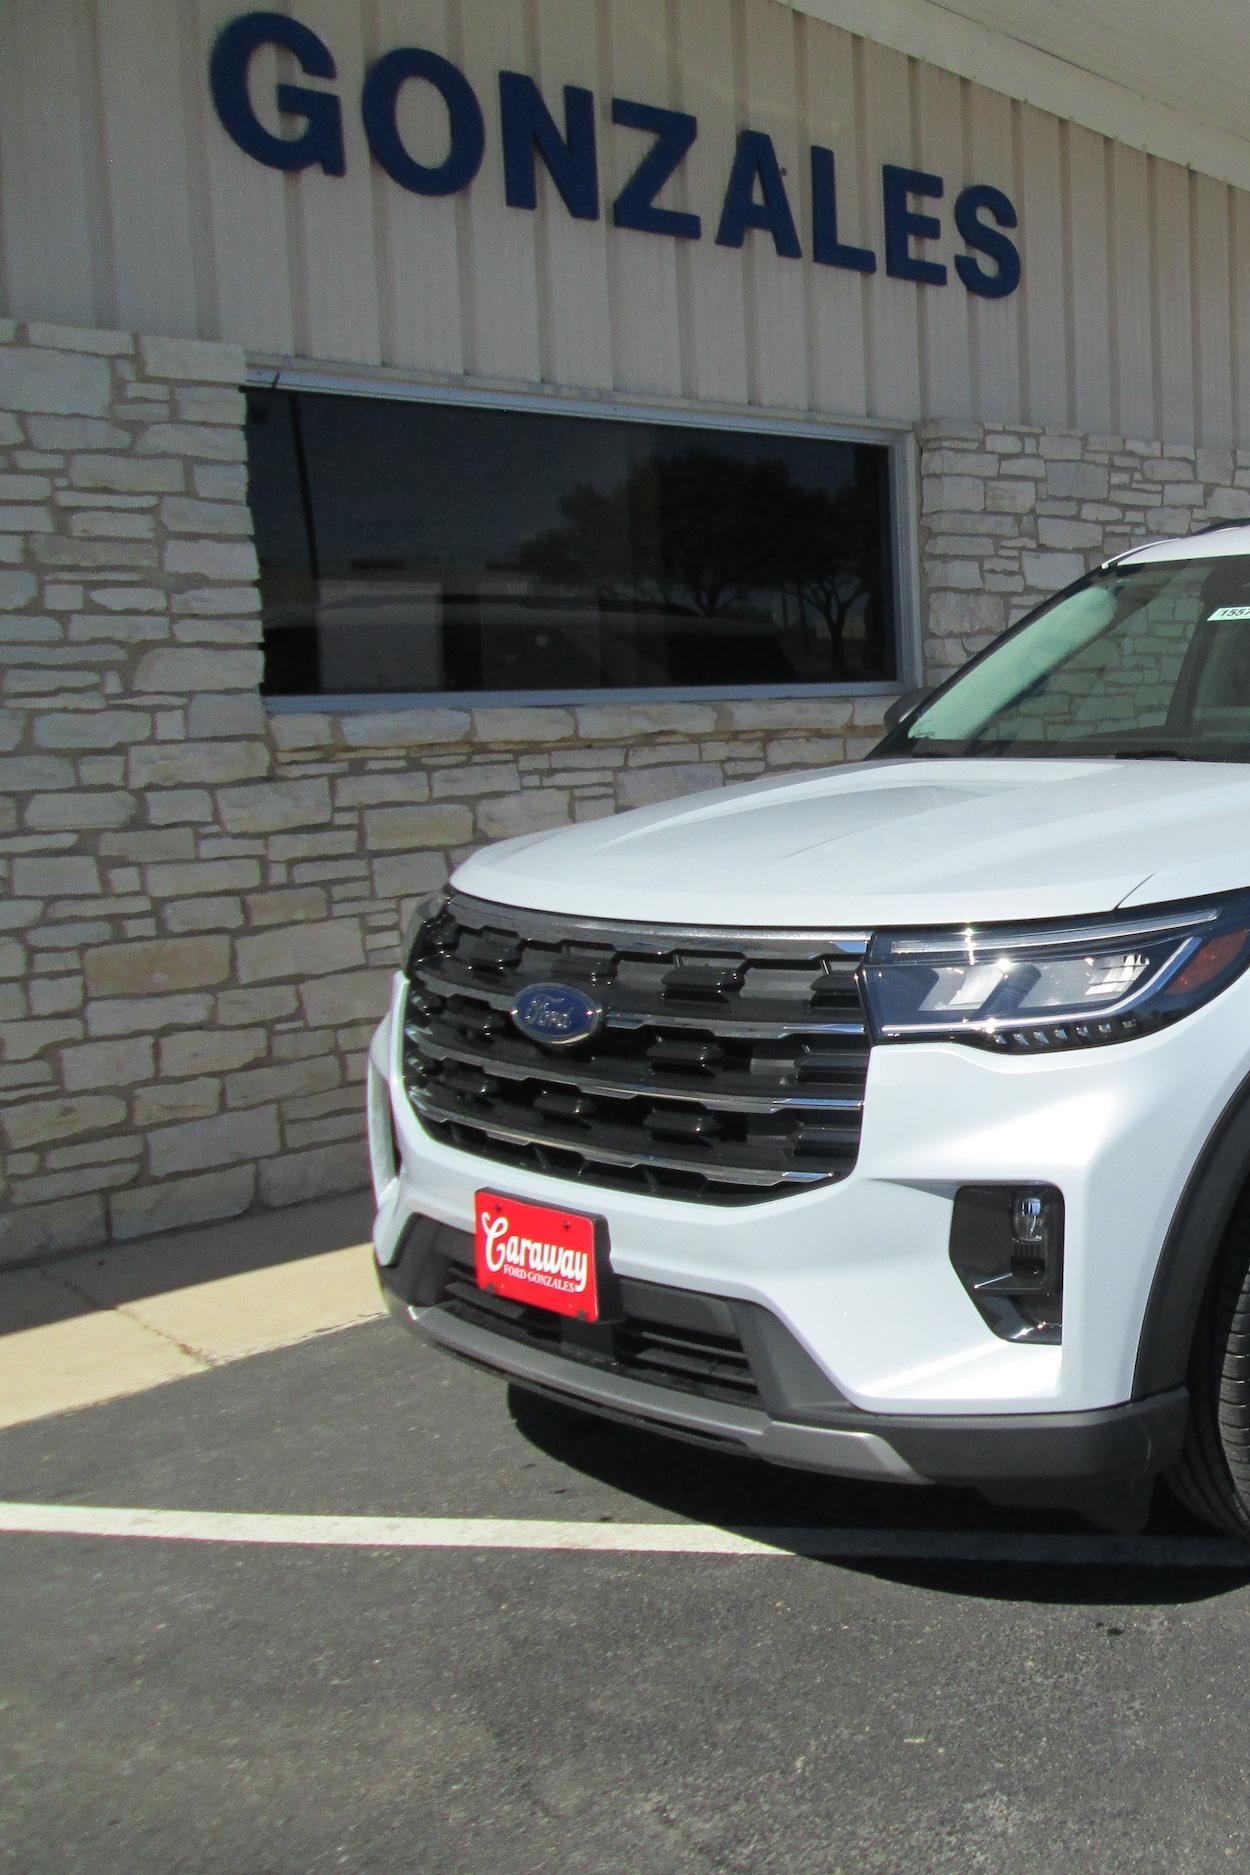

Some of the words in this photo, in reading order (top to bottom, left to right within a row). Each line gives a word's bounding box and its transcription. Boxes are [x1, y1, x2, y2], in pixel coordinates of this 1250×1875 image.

[209, 11, 1022, 300] GONZALES
[525, 993, 576, 1030] Ford
[481, 1212, 588, 1292] Caraway
[503, 1264, 527, 1280] FORD
[527, 1272, 575, 1293] GONZALES
